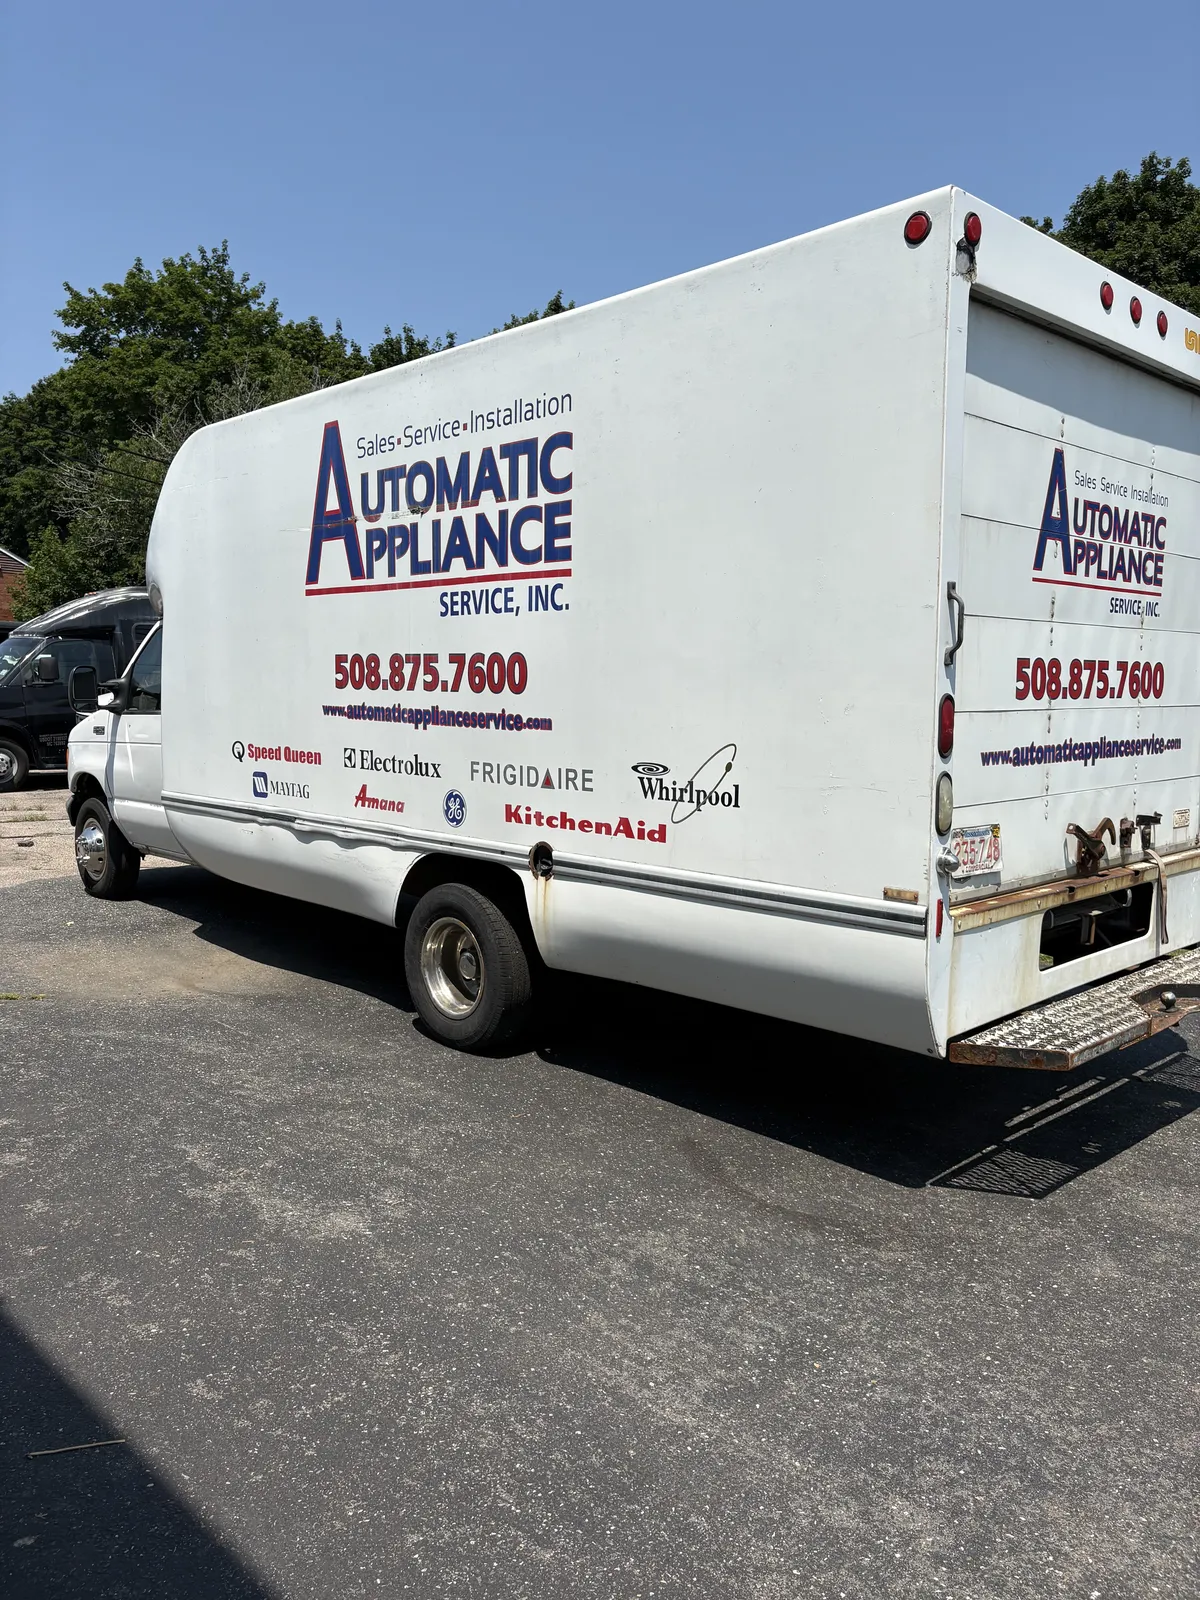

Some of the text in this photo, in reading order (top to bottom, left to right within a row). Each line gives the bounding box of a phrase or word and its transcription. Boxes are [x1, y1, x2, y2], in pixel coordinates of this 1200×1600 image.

[470, 393, 572, 433] Installation
[1074, 469, 1169, 508] Sales Service Installation
[439, 582, 570, 617] SERVICE, INC.
[1145, 601, 1161, 618] INC.
[334, 652, 528, 695] 508.875.7600
[1015, 657, 1165, 701] 508.875.7600
[322, 701, 553, 732] www.automaticapplianceservice.com
[247, 743, 282, 762] Speed
[283, 746, 322, 766] Queen
[359, 749, 442, 779] Electrolux
[980, 733, 1182, 768] www.automaticapplianceservice.com
[269, 780, 310, 799] MAYTAG
[470, 760, 594, 793] FRIGIDAIRE
[637, 776, 740, 812] Whirlpool
[354, 783, 405, 813] Amana
[505, 803, 667, 844] KitchenAid
